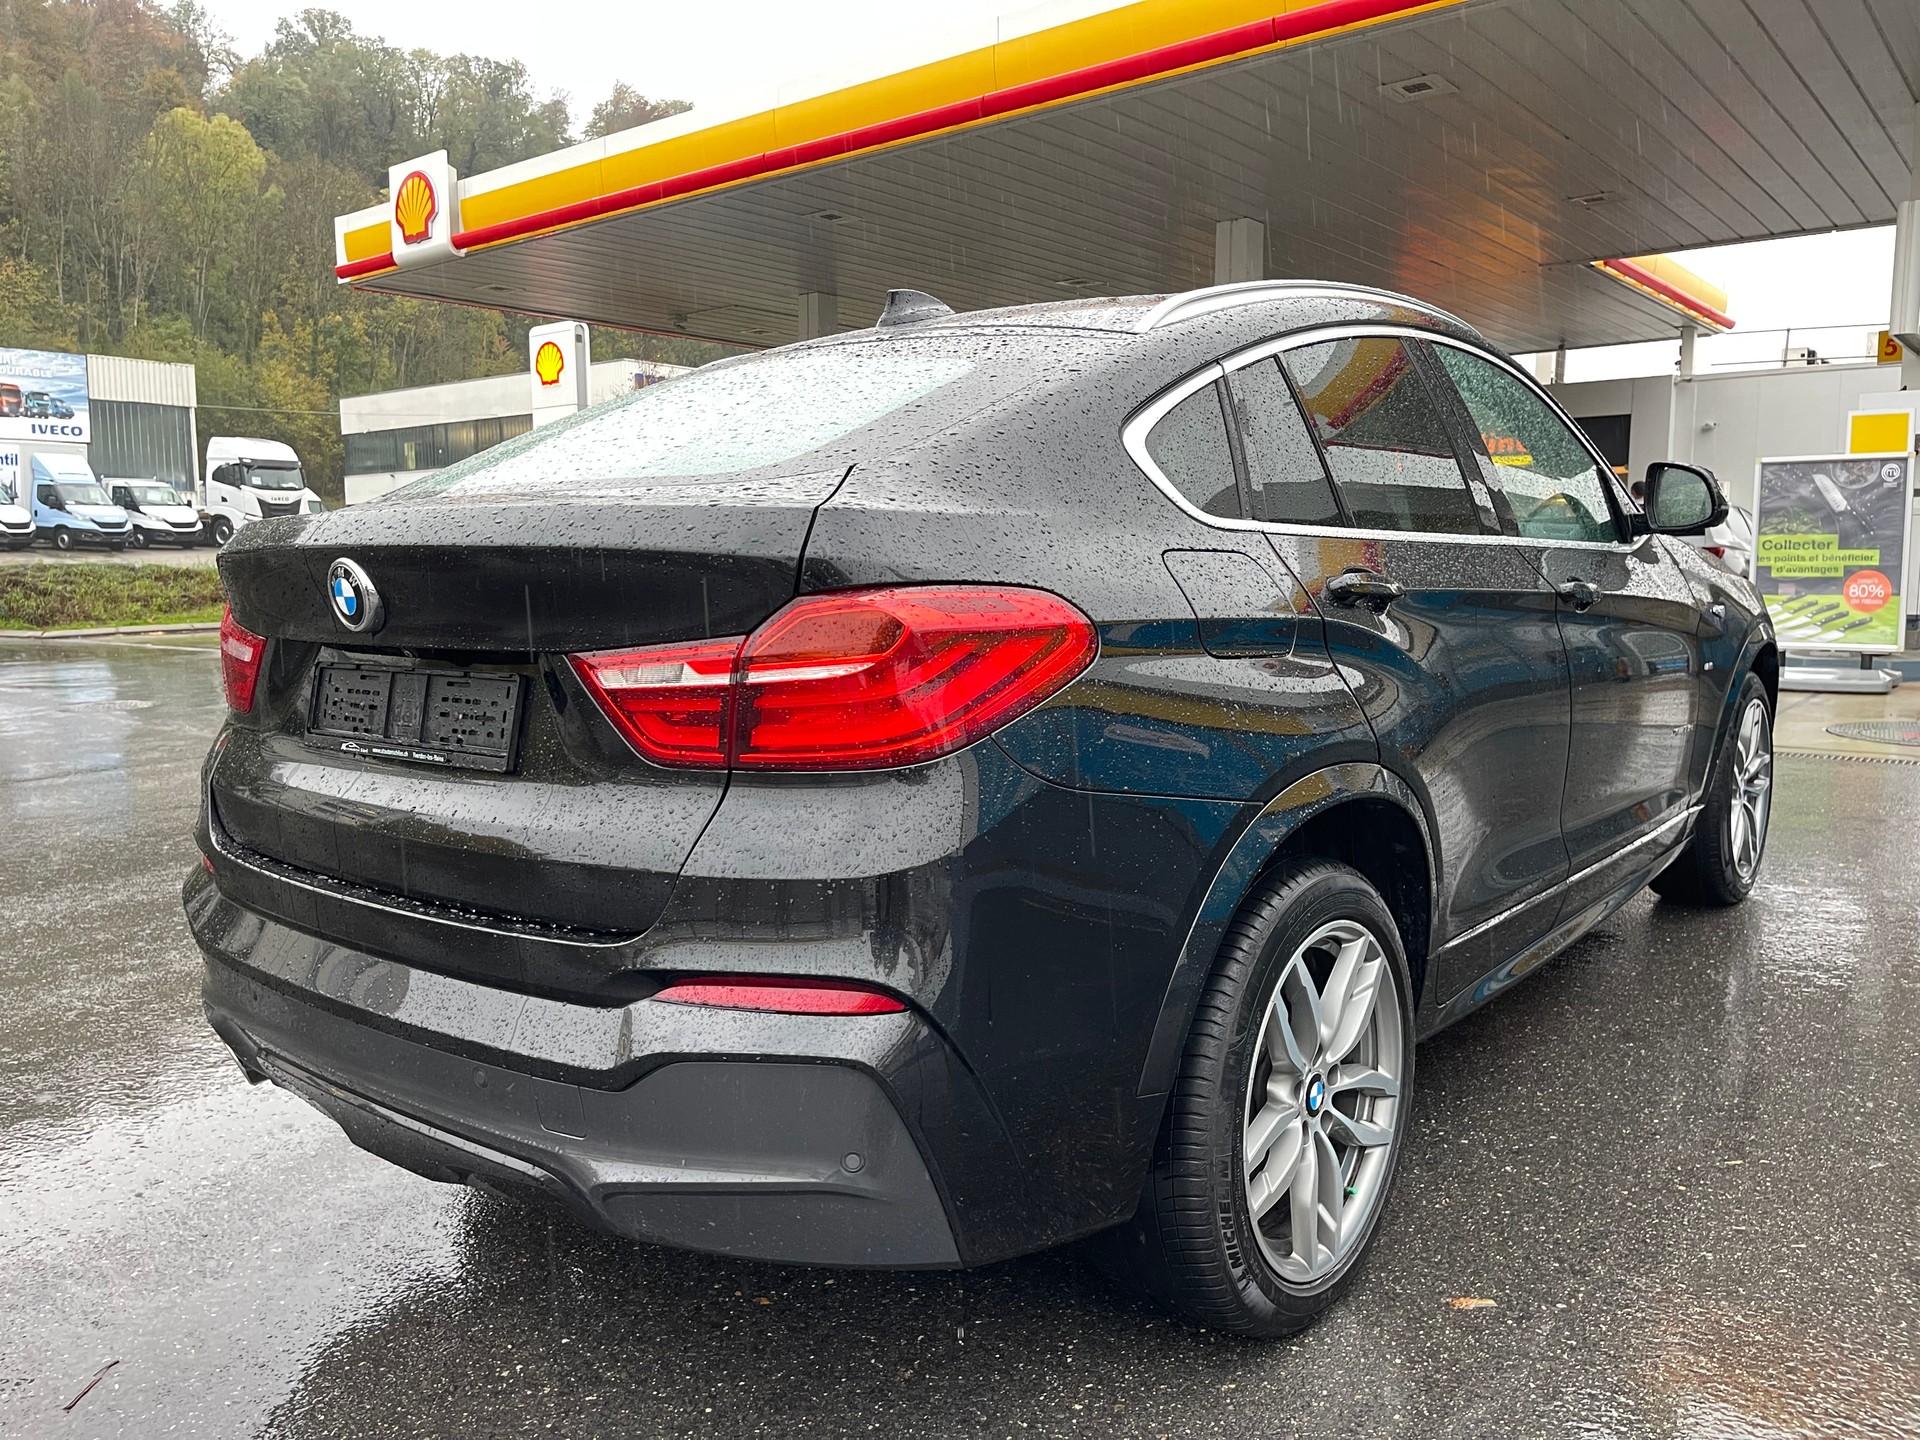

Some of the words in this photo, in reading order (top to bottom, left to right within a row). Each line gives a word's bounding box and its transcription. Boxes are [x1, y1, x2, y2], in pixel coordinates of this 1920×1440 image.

[1884, 338, 1898, 356] 5
[31, 423, 83, 437] IVECO
[1762, 539, 1833, 551] Collecter
[1774, 554, 1806, 563] points
[1822, 553, 1874, 562] bénéficier
[1776, 565, 1839, 575] d'avantages
[1848, 584, 1885, 598] 80%
[1215, 1159, 1245, 1270] MICHELIN
